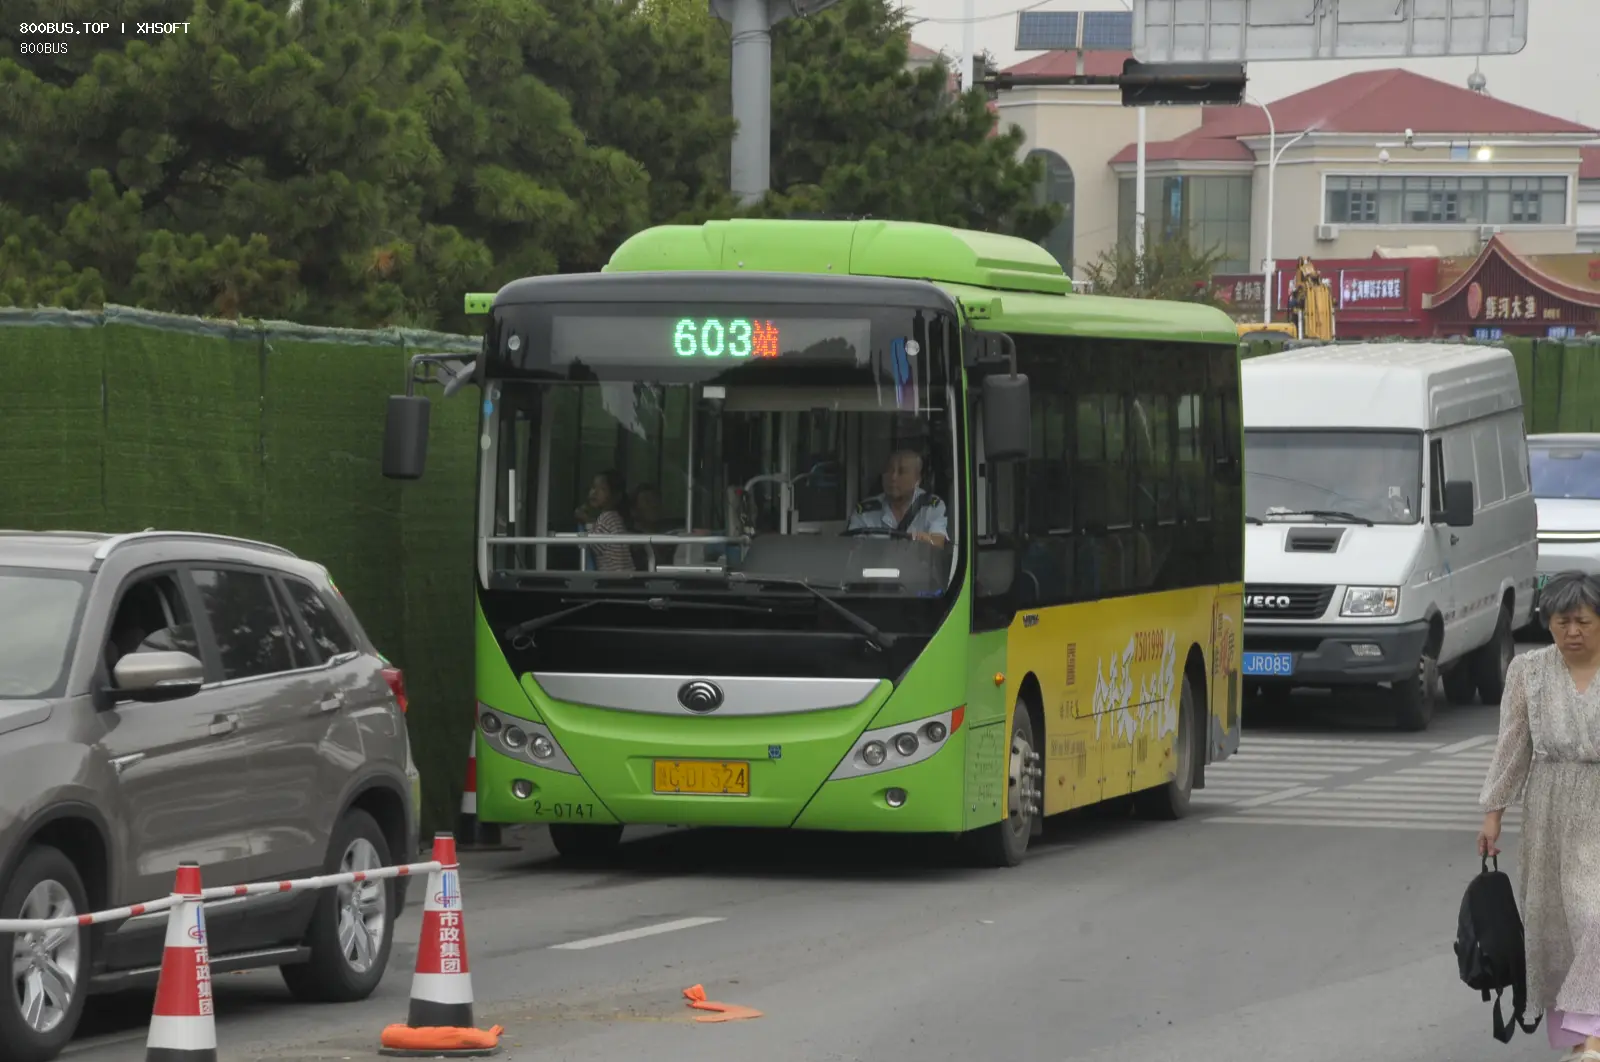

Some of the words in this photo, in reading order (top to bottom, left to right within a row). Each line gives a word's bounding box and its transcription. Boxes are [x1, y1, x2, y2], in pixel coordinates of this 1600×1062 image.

[674, 318, 752, 357] 603
[1243, 595, 1290, 608] VECO
[1247, 656, 1290, 671] JR085
[533, 801, 594, 819] 2-0747
[439, 911, 461, 974] 市政集团
[194, 947, 214, 1016] 市政集团
